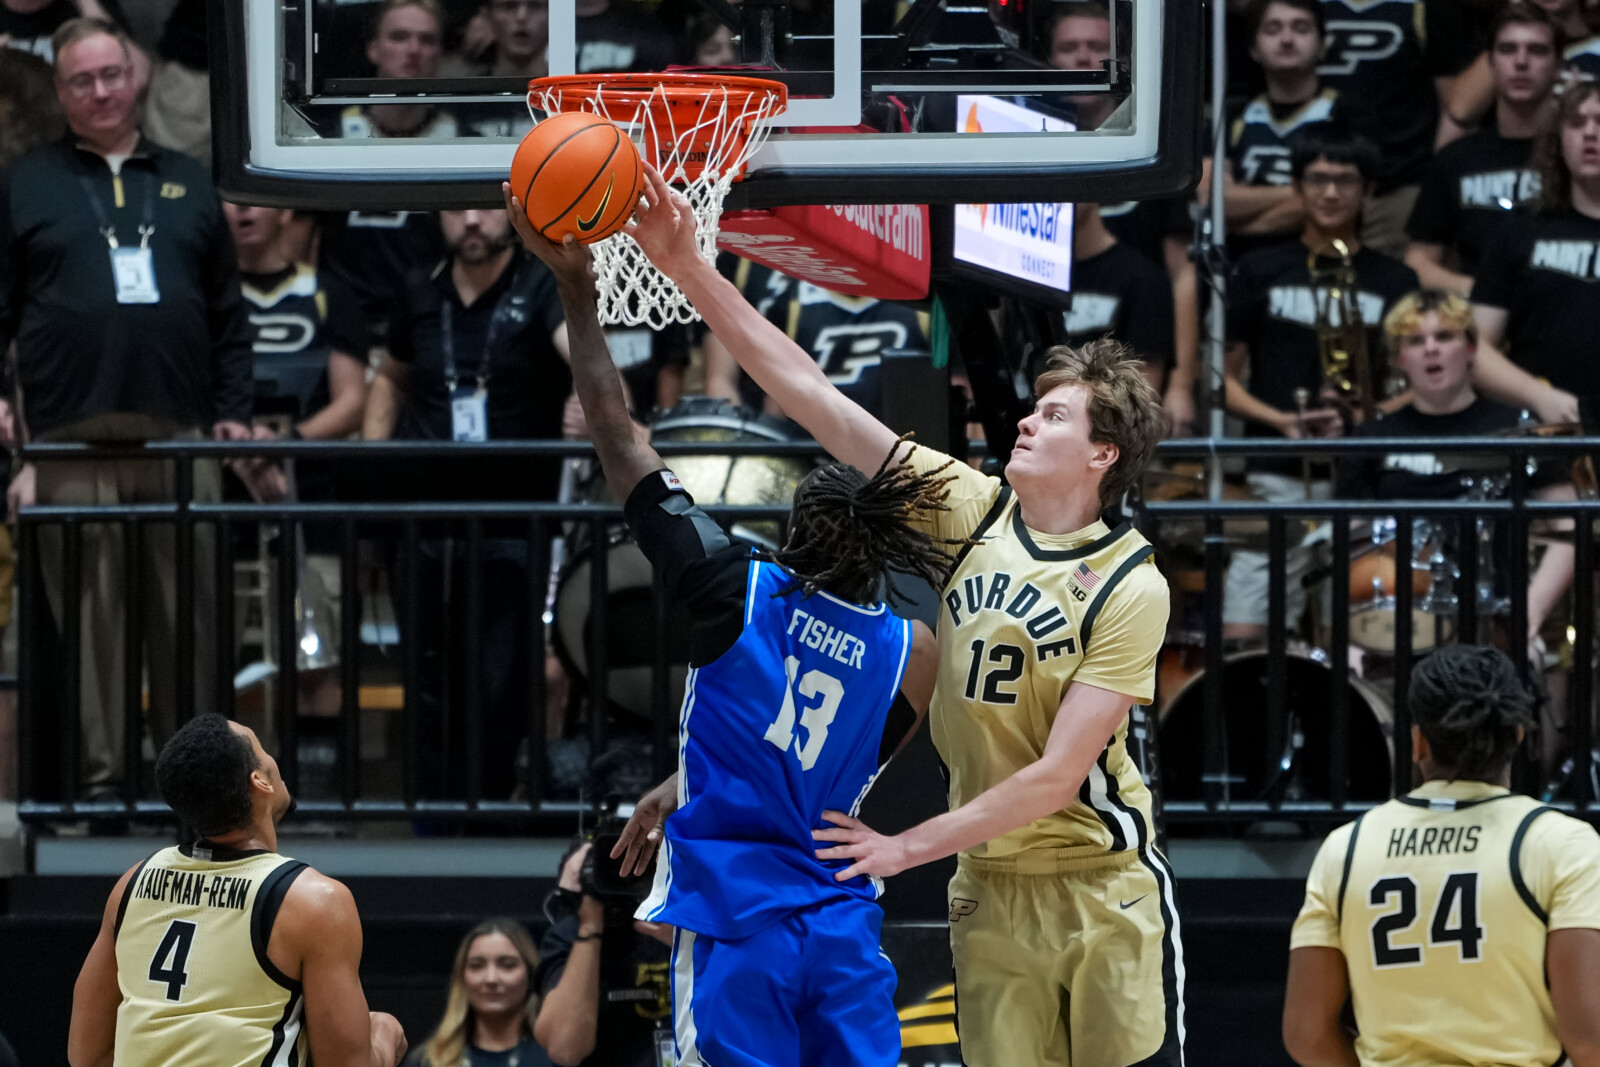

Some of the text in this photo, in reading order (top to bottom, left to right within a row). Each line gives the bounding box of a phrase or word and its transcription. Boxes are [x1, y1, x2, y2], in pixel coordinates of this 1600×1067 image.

[1021, 253, 1055, 279] CONNECT
[787, 608, 867, 670] FISHER
[945, 572, 1077, 662] PURDUE
[963, 638, 1026, 706] 12
[763, 655, 845, 771] 13
[1387, 826, 1482, 858] HARRIS
[135, 868, 253, 910] KAUFMAN-RENN
[1367, 870, 1487, 969] 24
[148, 919, 198, 1002] 4
